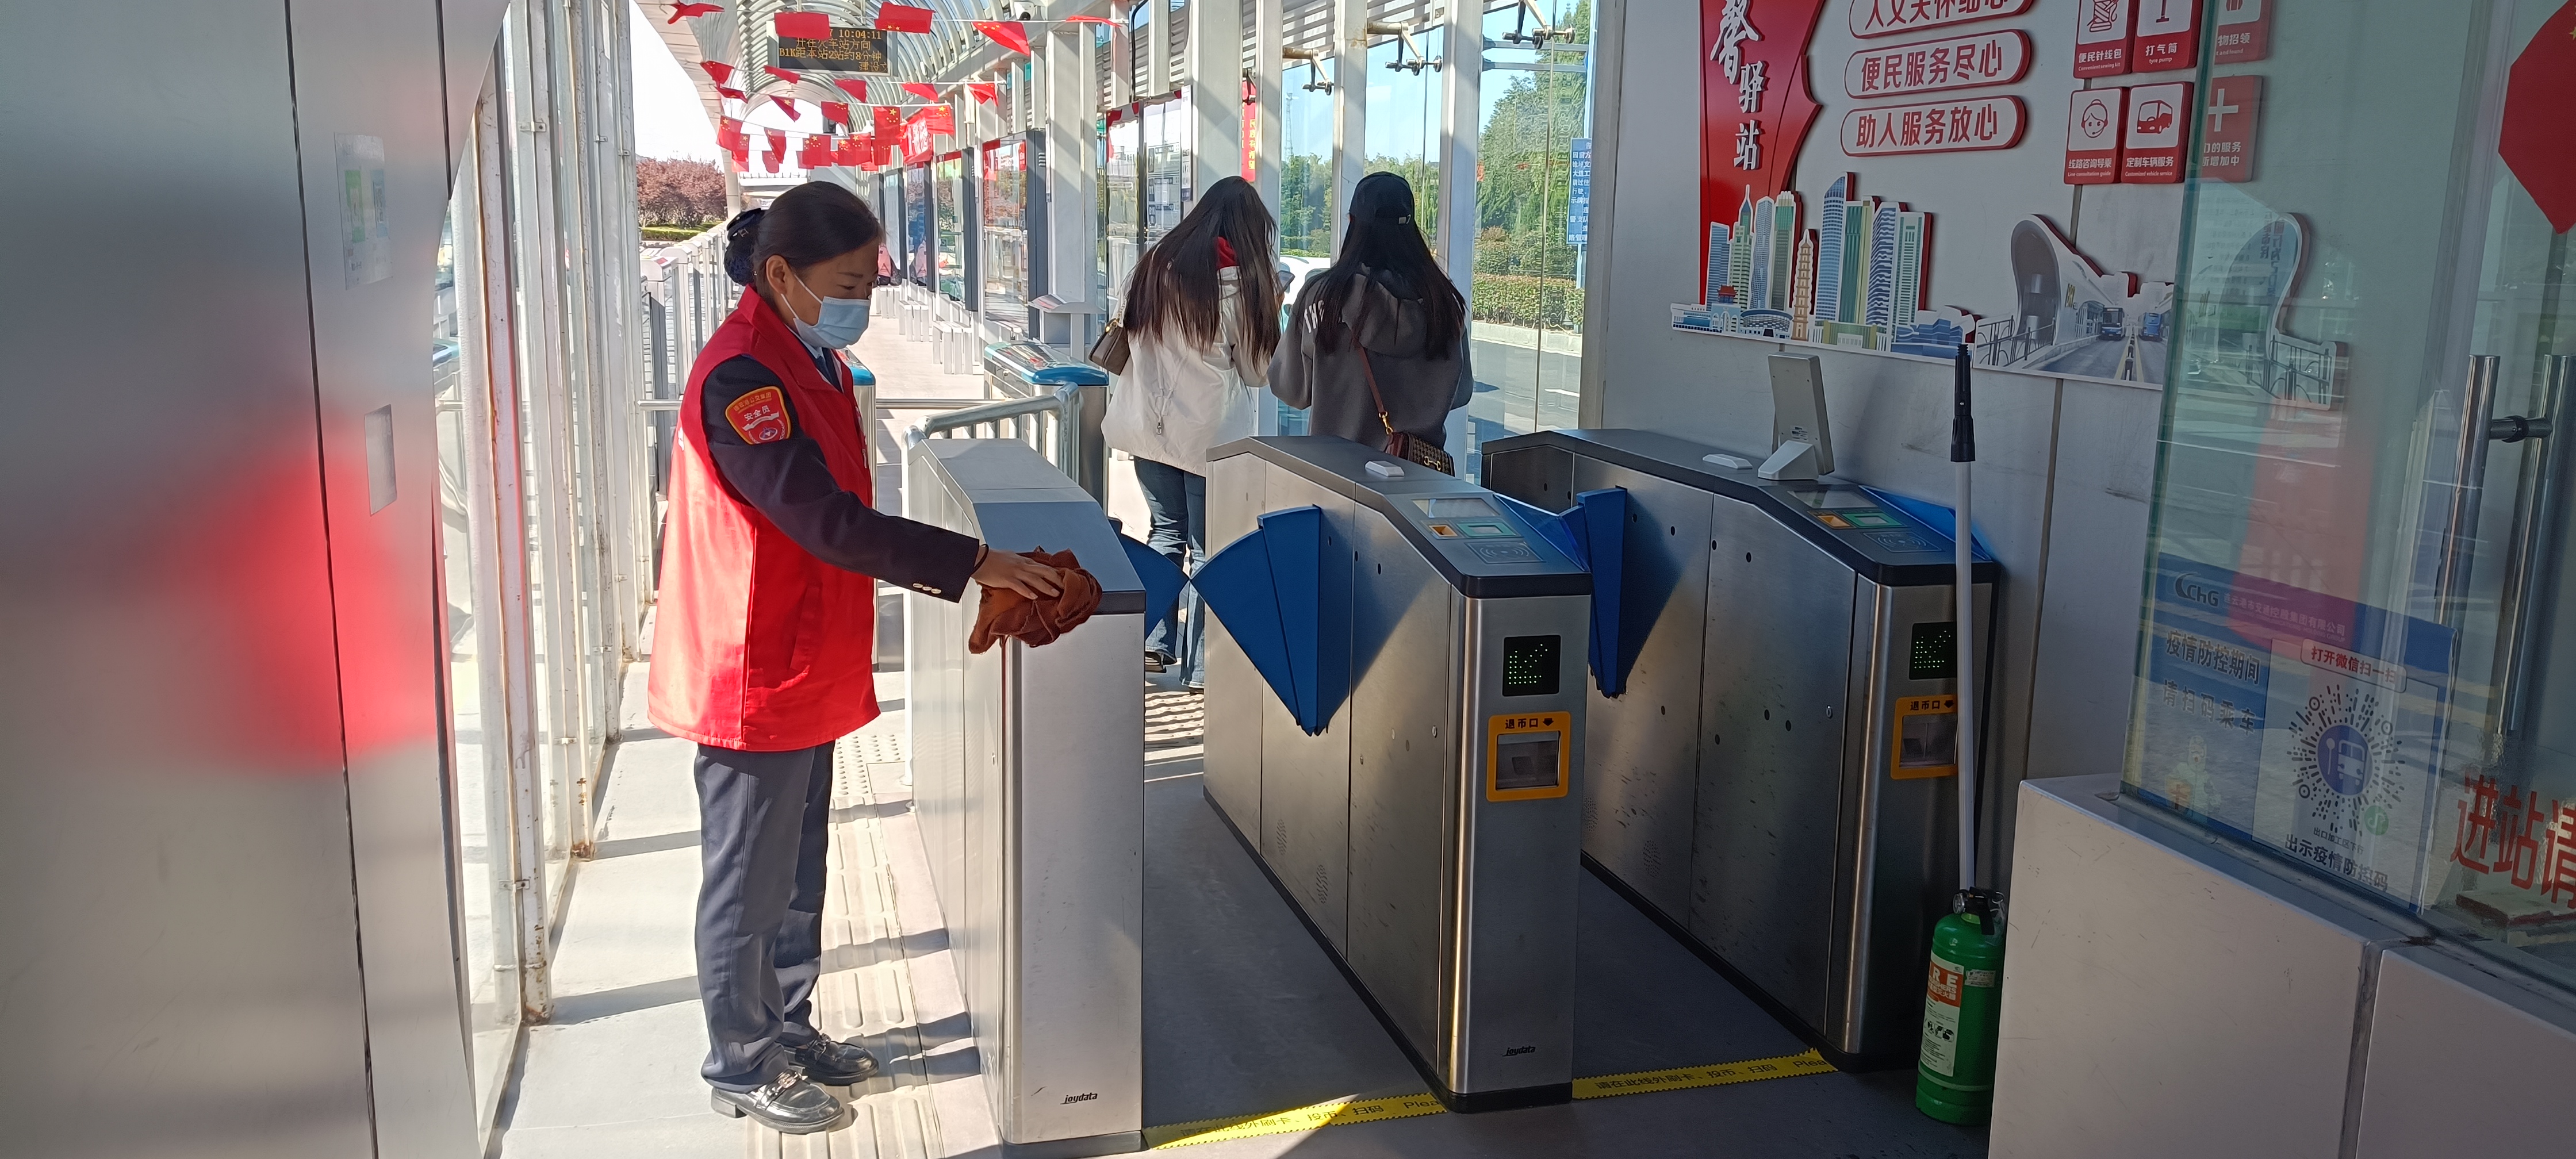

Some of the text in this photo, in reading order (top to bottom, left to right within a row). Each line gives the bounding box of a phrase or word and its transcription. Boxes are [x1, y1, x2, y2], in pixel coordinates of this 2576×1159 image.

[839, 29, 881, 40] 10:04:11
[795, 36, 871, 51] 开往火车站方向
[2145, 43, 2178, 56] 打气筒
[779, 47, 881, 62] B1K距本站2站约8分钟
[2079, 48, 2122, 63] 便民针线包
[1861, 40, 2002, 92] 便民服务尽心
[1856, 103, 1997, 148] 助人服务放心
[2068, 158, 2112, 169] 线路咨询导乘
[2126, 156, 2174, 168] 定制车辆服务
[743, 405, 770, 421] 安全员
[2166, 630, 2261, 685] 疫情防控期间
[2311, 646, 2397, 684] 打开微信扫一扫
[1910, 700, 1941, 711] 退币口
[2163, 680, 2256, 736] 请扫码乘车
[1505, 718, 1538, 730] 退币口
[2313, 827, 2364, 855] 出口加工区下行
[2450, 772, 2576, 909] 进站请
[2285, 834, 2388, 891] 出示疫情防控码
[1502, 1045, 1536, 1057] joydata
[1594, 1058, 1828, 1089] 请在此线外刷卡、投币、扫码 Plea
[1060, 1092, 1098, 1104] joydata
